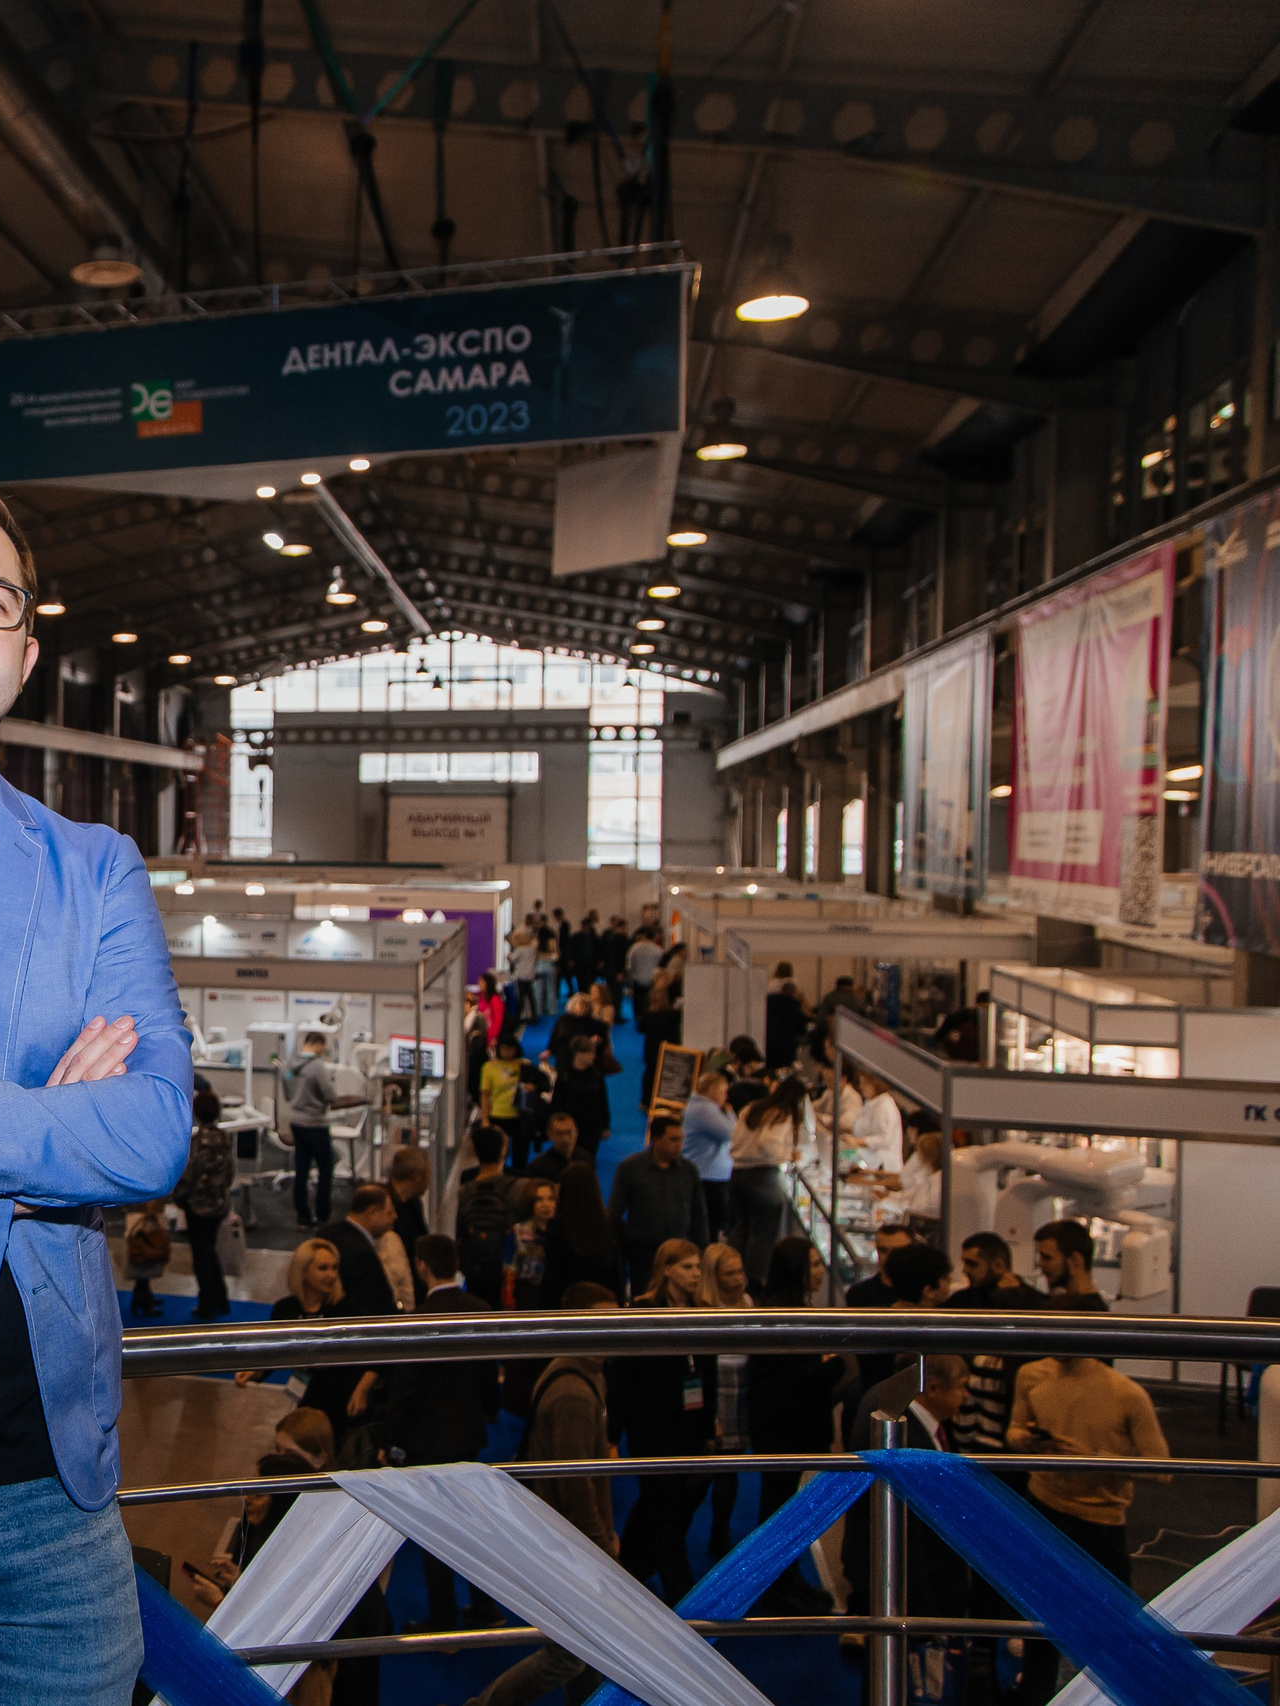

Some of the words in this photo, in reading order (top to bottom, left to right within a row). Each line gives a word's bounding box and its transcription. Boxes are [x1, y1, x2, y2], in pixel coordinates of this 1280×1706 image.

[281, 324, 532, 376] ДЕНТАЛ-ЭКСПО
[389, 359, 532, 397] САМАРА
[445, 400, 531, 437] 2023
[411, 827, 461, 839] ВЫХОД
[1244, 1104, 1267, 1121] ГК
